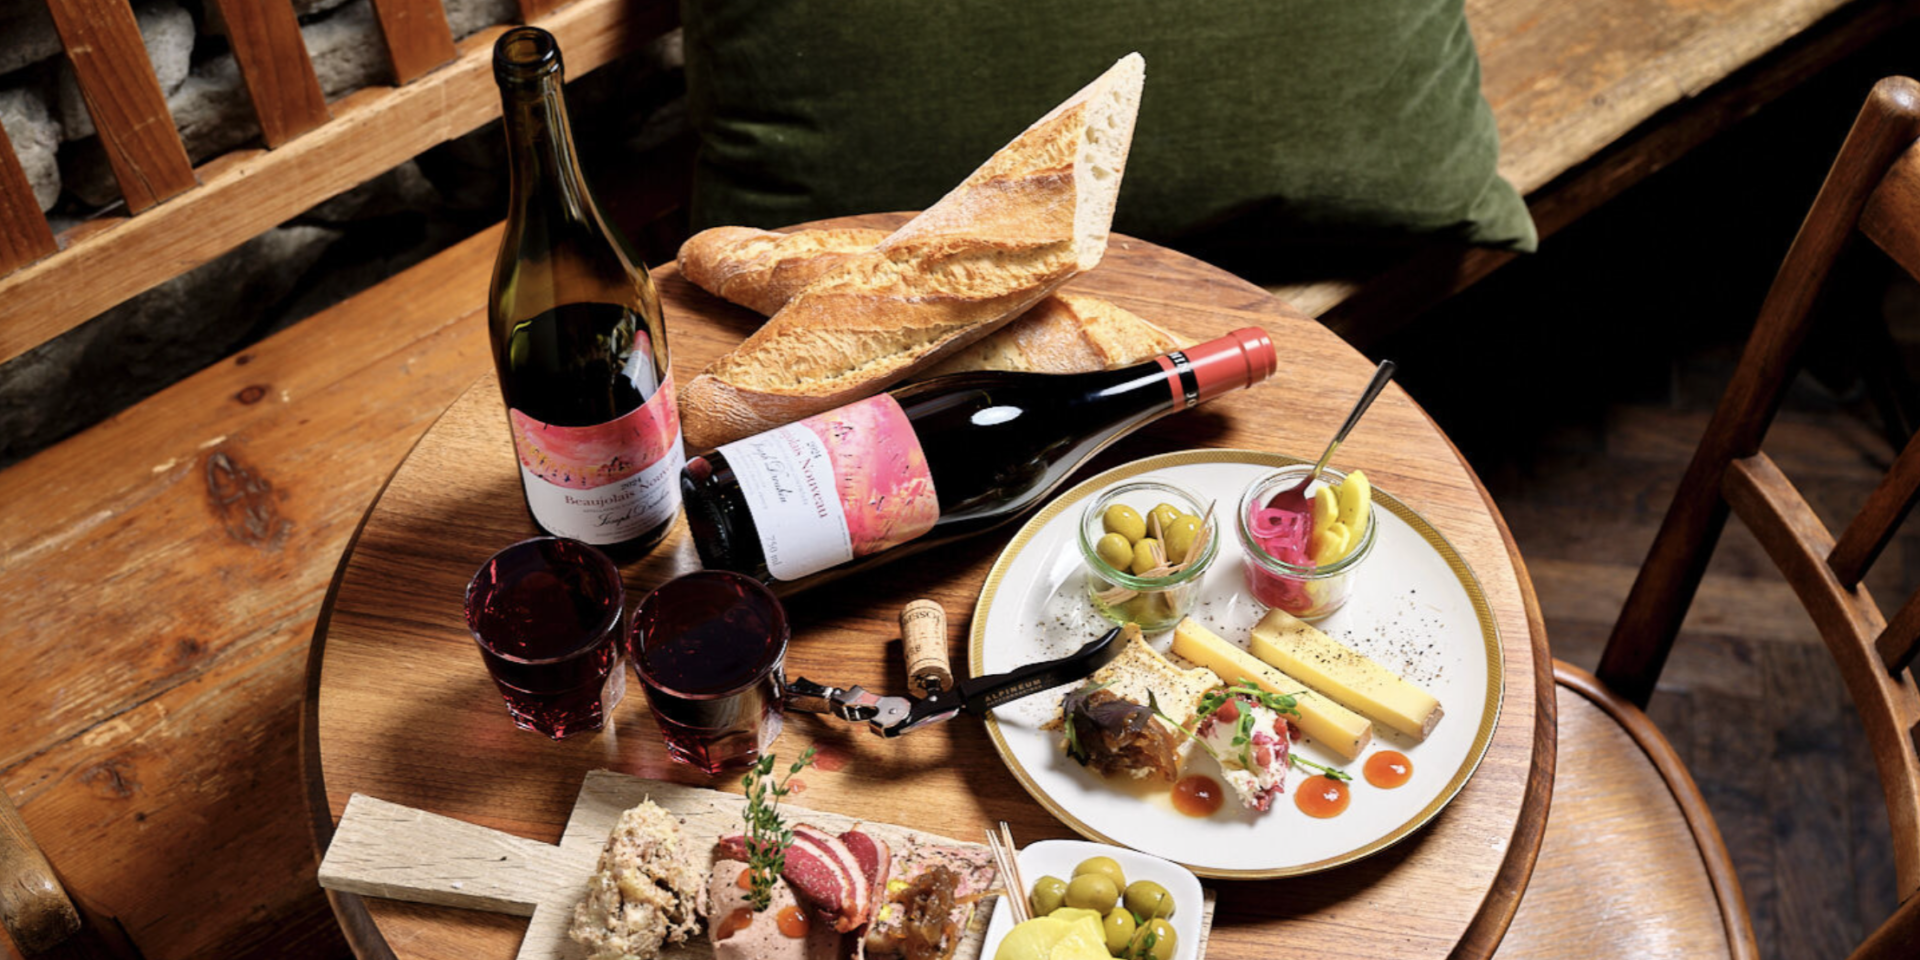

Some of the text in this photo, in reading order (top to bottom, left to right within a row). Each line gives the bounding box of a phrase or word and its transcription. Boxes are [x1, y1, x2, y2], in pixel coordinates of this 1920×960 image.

[806, 441, 822, 459] 2024
[621, 476, 641, 490] 2024
[799, 457, 828, 518] Nouveau
[564, 491, 636, 508] Beaujolais
[985, 678, 1042, 702] ALPINEUM
